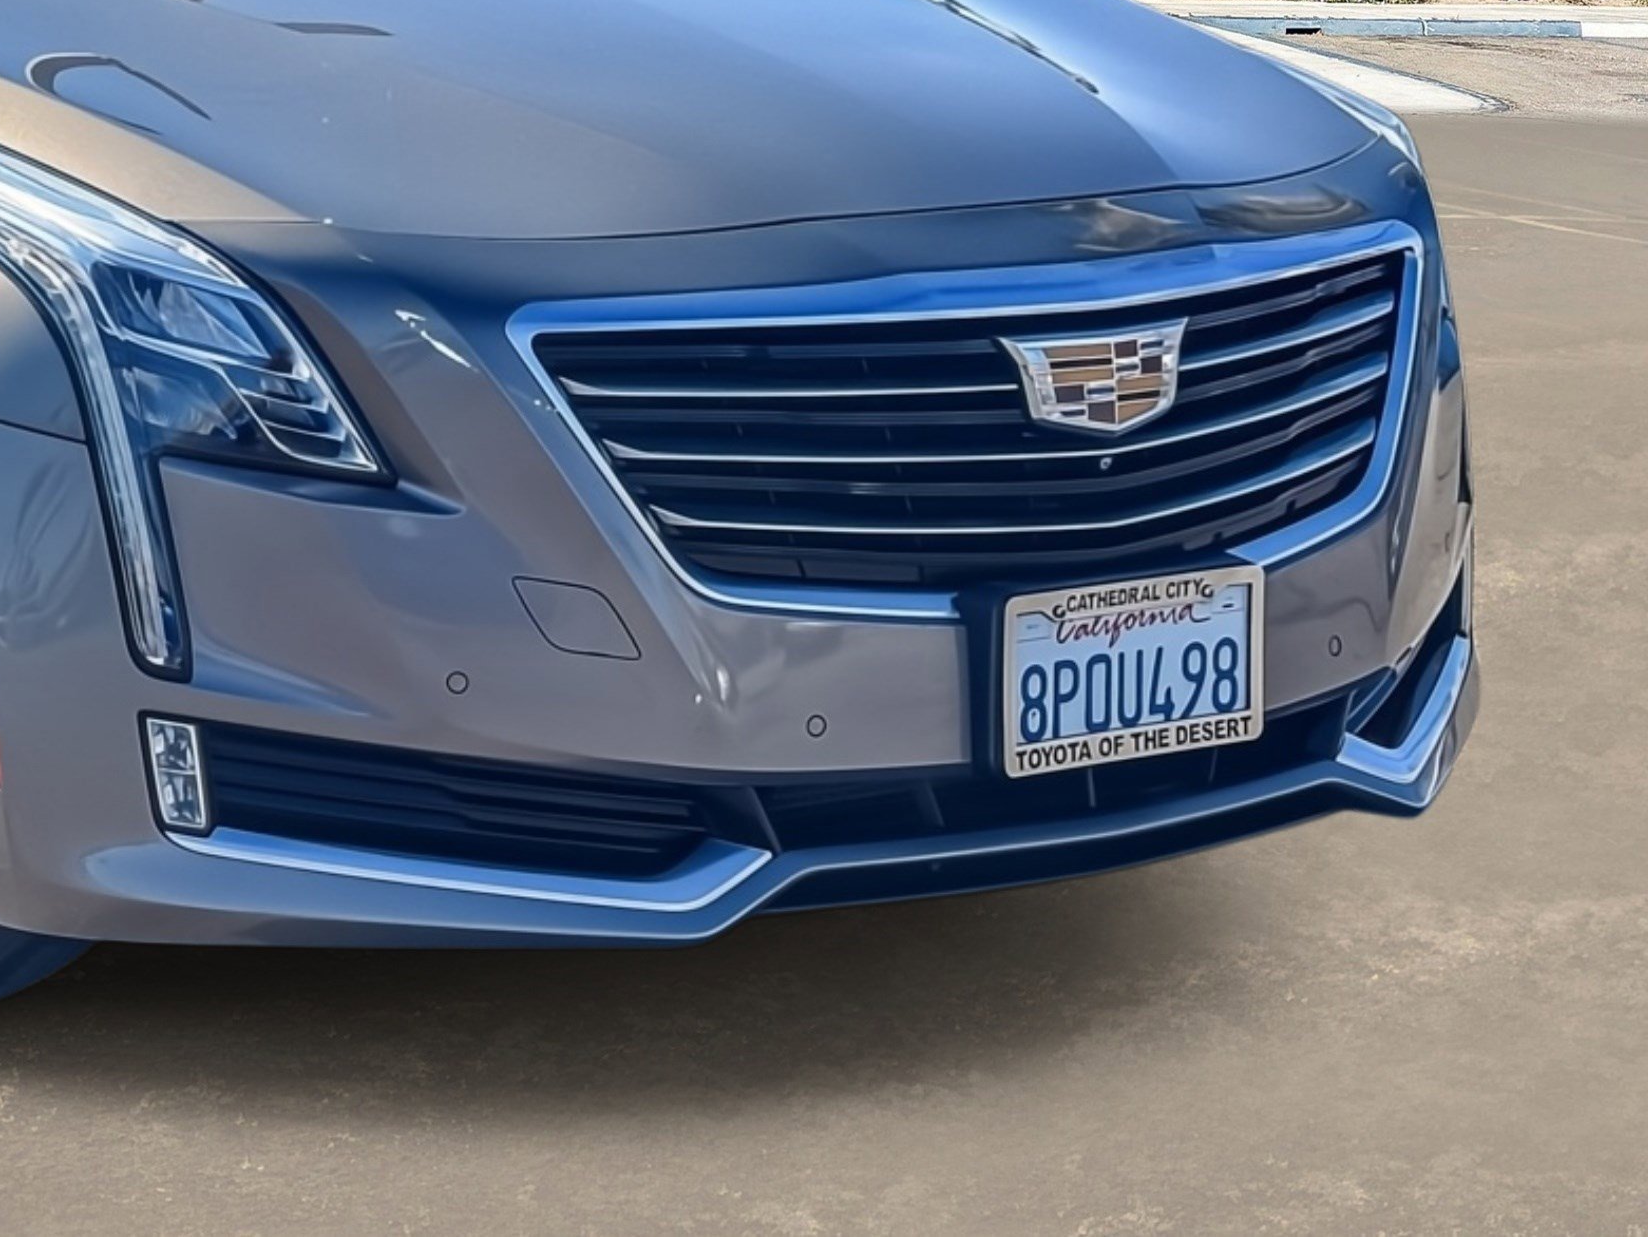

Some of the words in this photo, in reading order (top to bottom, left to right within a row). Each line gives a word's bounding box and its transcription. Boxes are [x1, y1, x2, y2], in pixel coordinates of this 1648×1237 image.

[1066, 583, 1160, 613] CATHEDRAL
[1166, 578, 1204, 599] CITY
[1016, 743, 1092, 771] TOYOTA
[1098, 734, 1125, 757] OF
[1130, 727, 1170, 752] THE
[1175, 716, 1252, 745] DESERT
